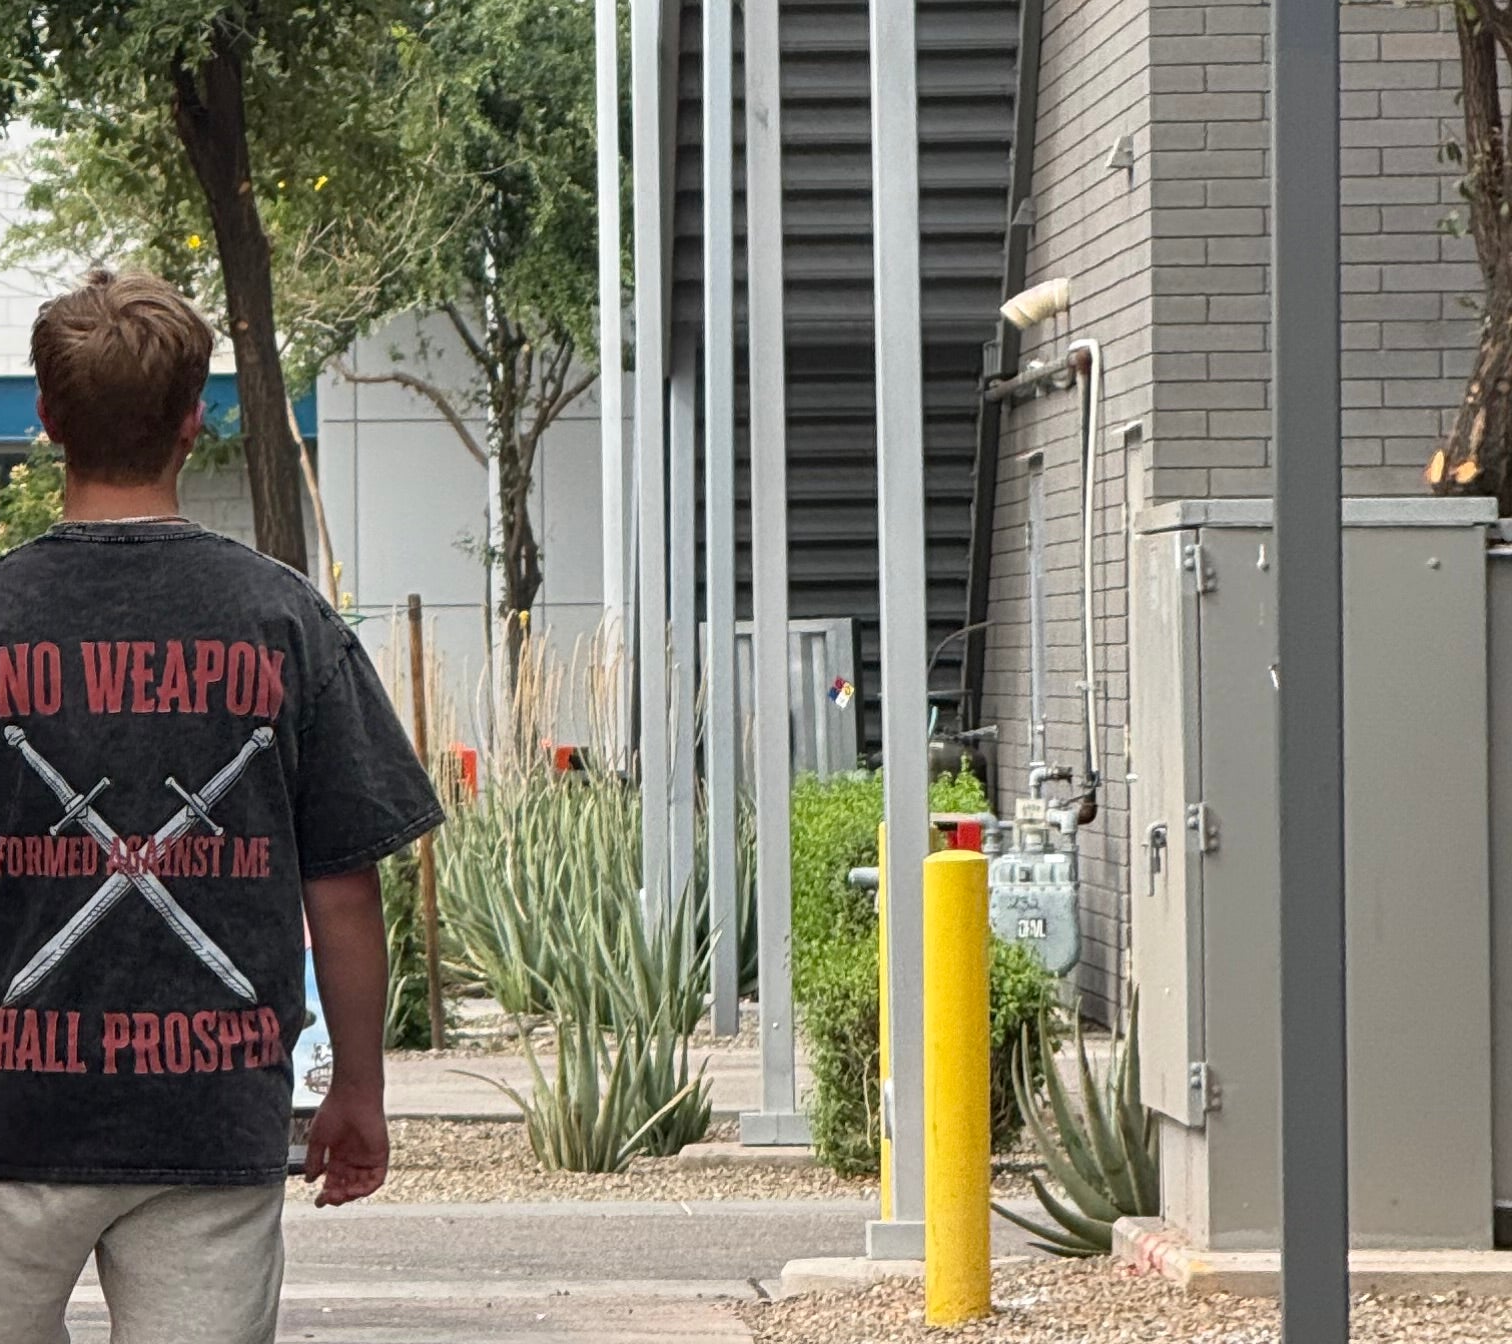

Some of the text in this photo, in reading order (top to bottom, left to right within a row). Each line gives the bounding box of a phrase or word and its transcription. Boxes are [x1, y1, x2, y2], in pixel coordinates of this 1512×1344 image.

[81, 639, 285, 720] WEAPON
[106, 835, 224, 877] AGAINST
[231, 836, 271, 878] ME
[102, 1007, 287, 1074] PROSPER
